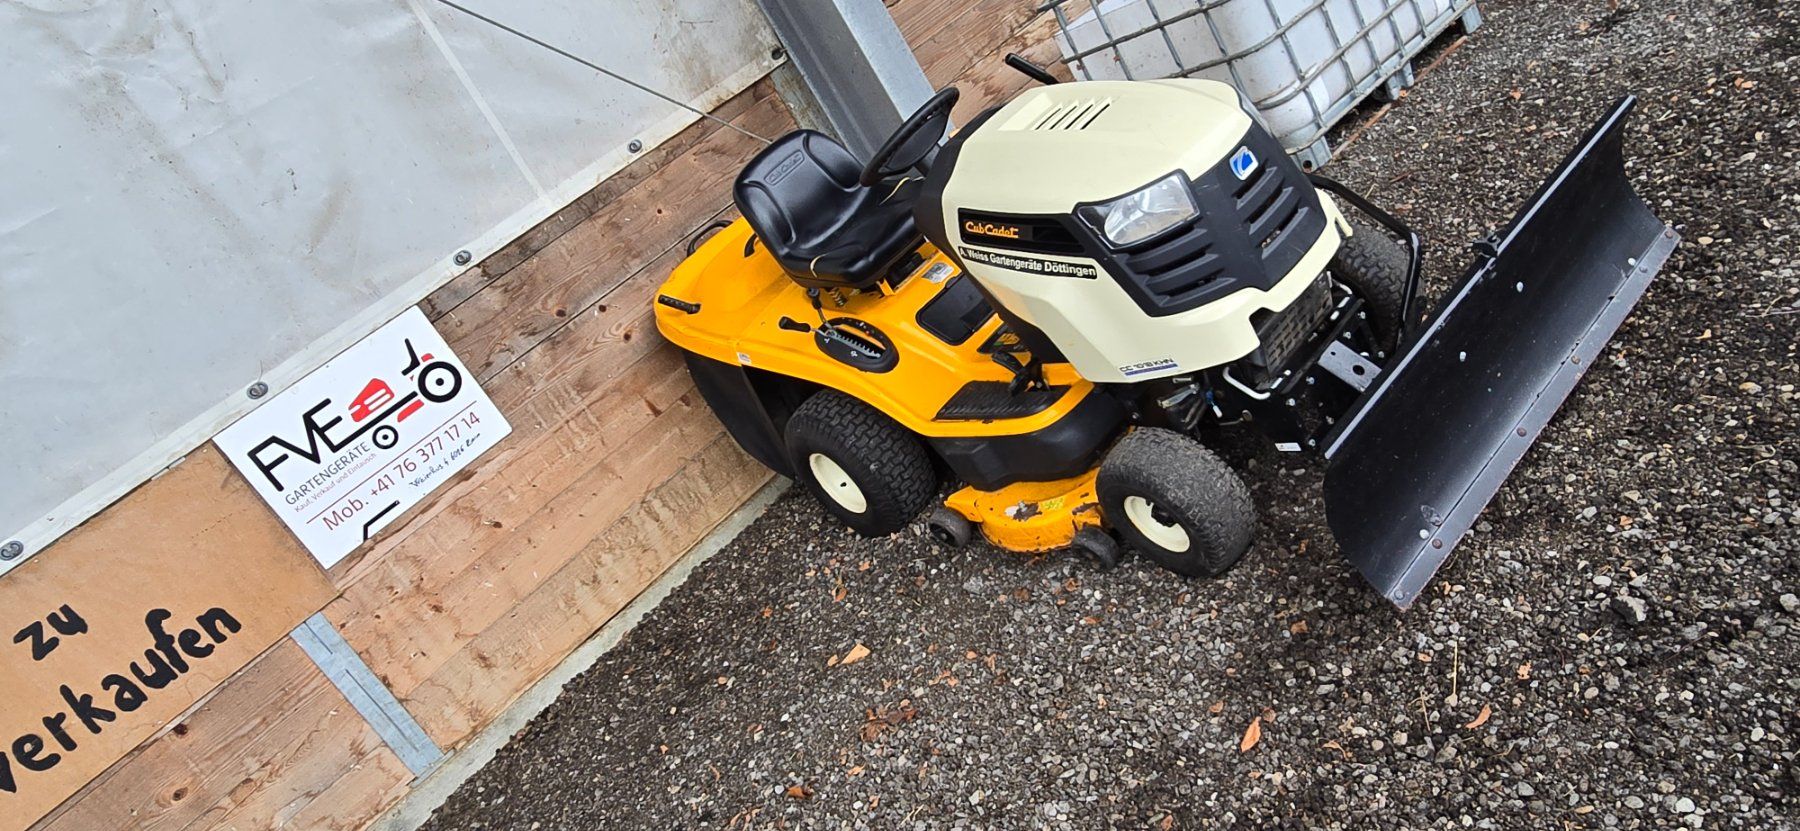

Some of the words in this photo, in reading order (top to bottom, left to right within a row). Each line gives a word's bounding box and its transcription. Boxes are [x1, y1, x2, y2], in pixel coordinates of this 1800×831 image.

[965, 220, 984, 234] Cub
[968, 249, 989, 262] Weiss
[990, 252, 1042, 270] Gartengeräte
[1044, 261, 1096, 276] Döttingen
[247, 397, 352, 493] FVE
[285, 442, 371, 505] GARTENGERÄTE
[322, 499, 369, 531] Mob.
[371, 474, 395, 496] +41
[393, 458, 417, 479] 76
[416, 436, 443, 463] 377
[444, 424, 460, 441] 17
[461, 411, 480, 429] 14
[294, 498, 315, 513] Kauf,
[311, 481, 336, 500] Verkauf
[336, 471, 350, 484] und
[347, 452, 377, 475] Eintausch
[13, 604, 88, 661] zu
